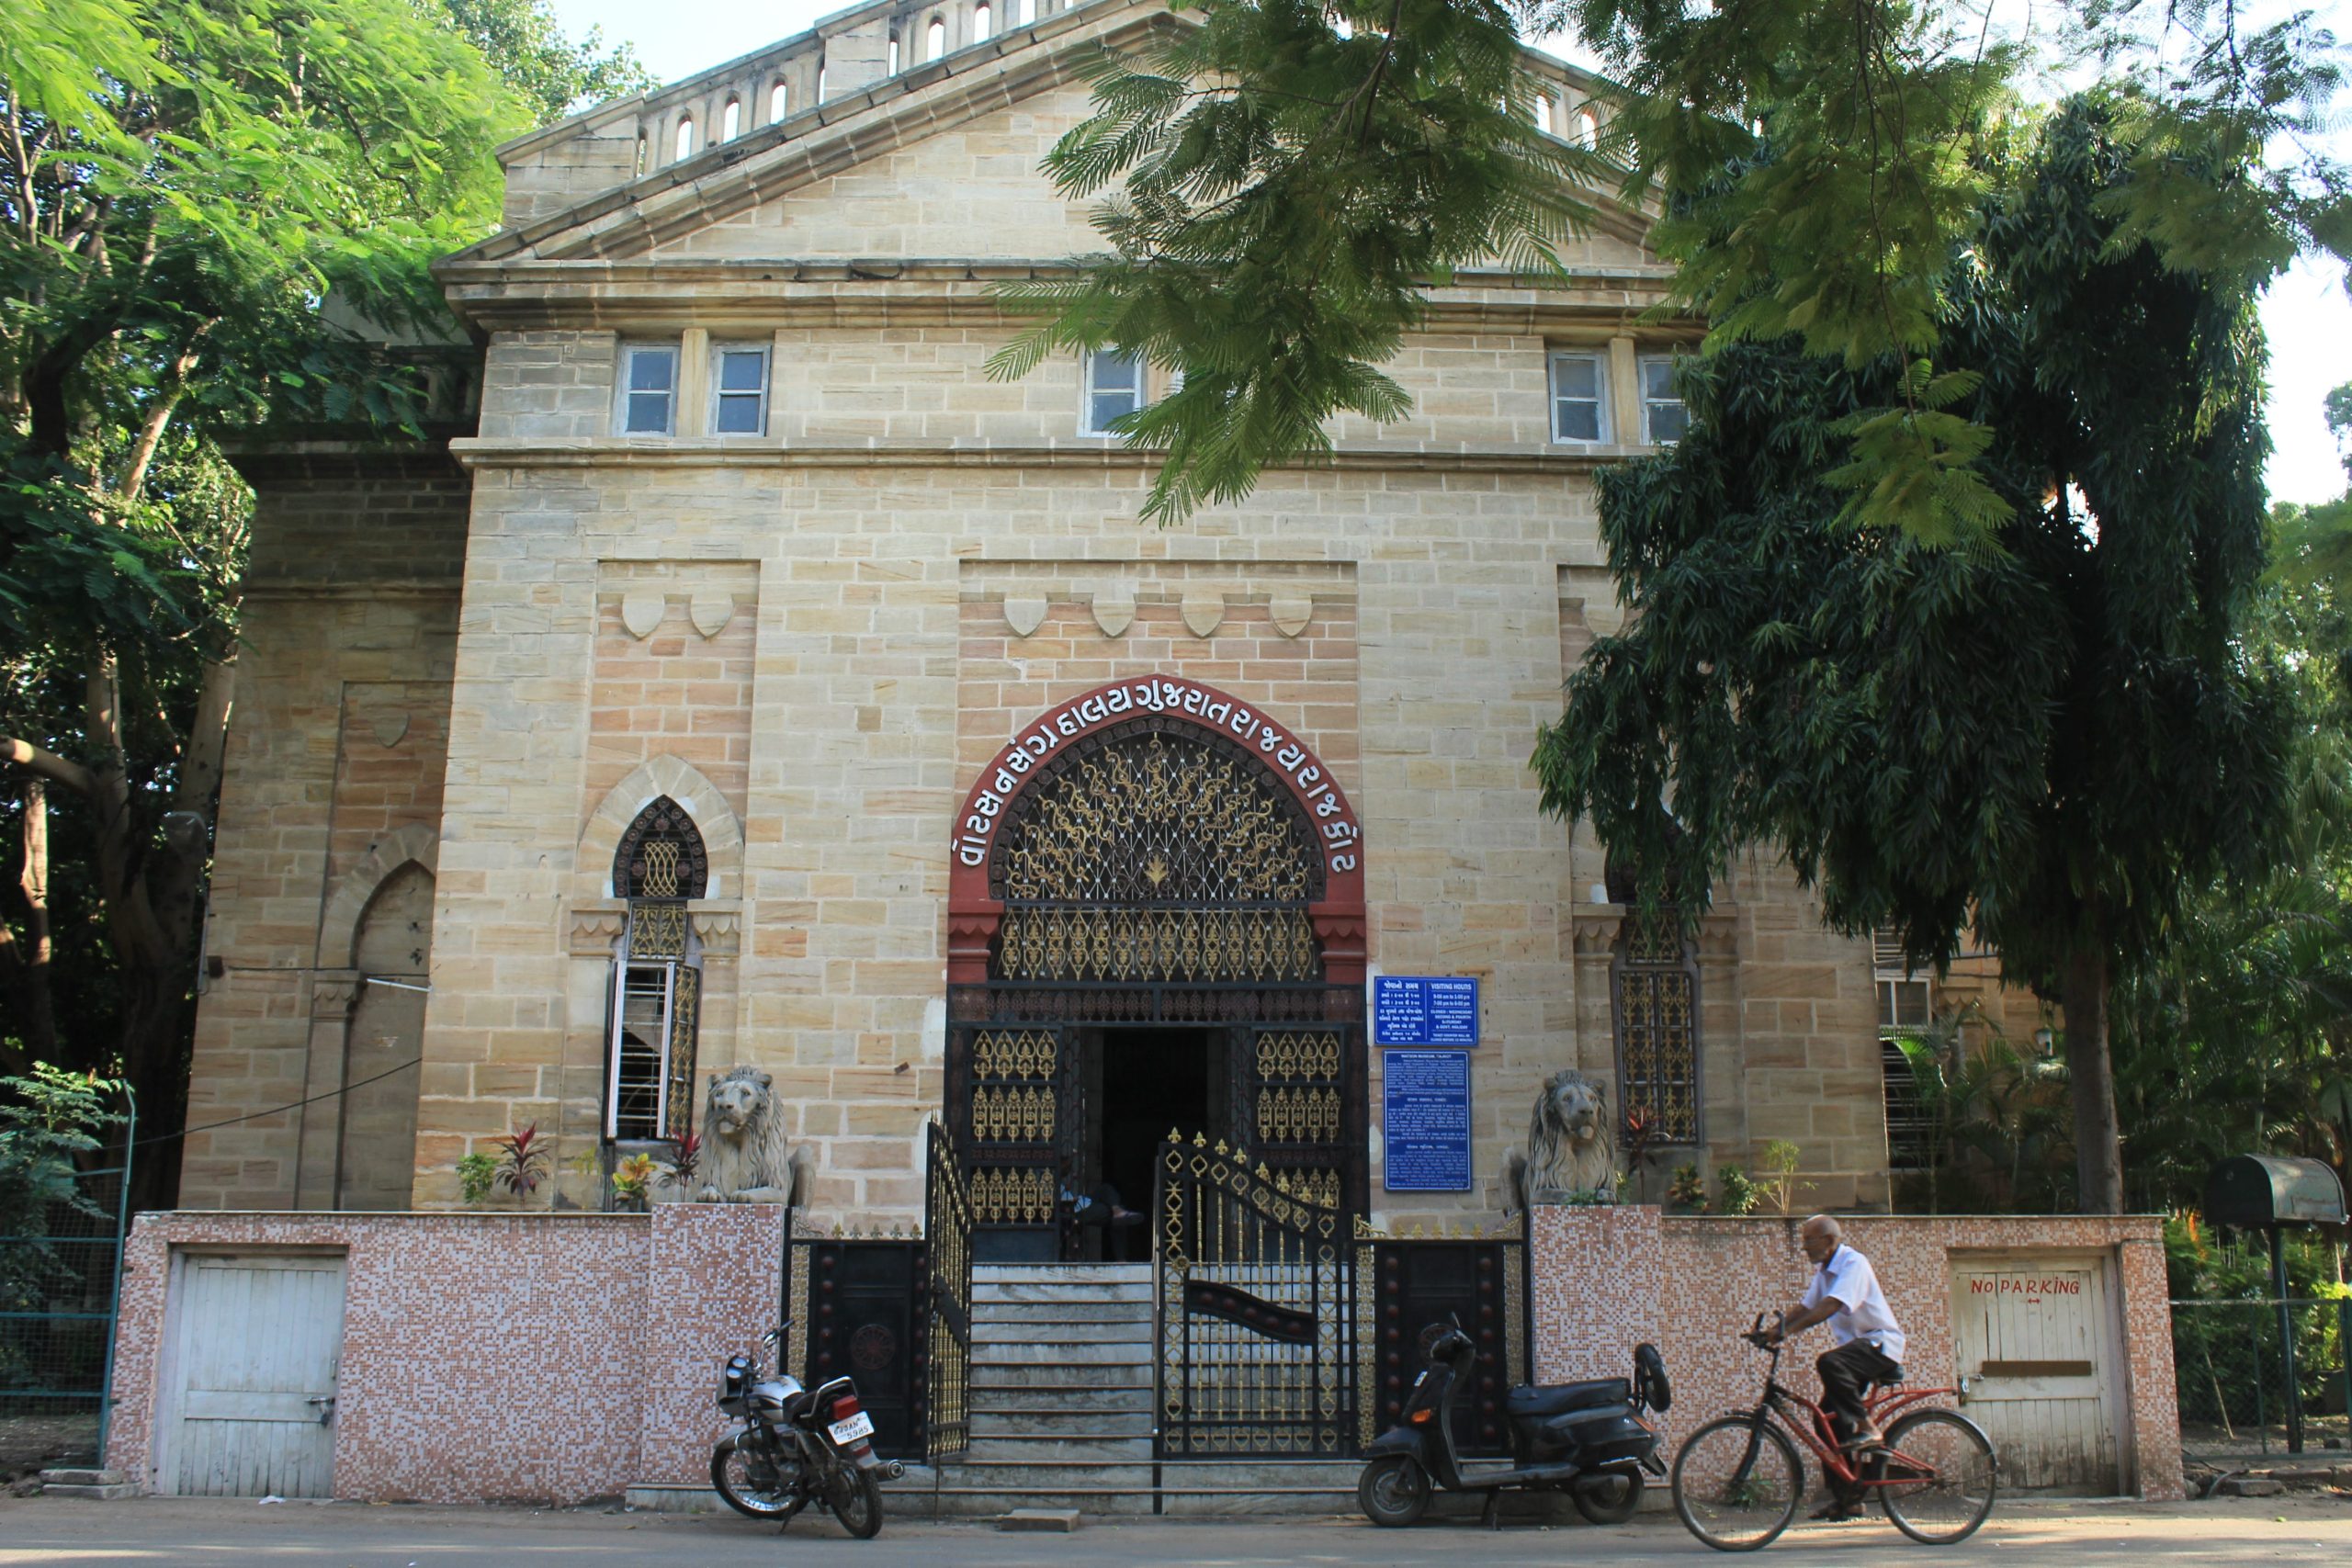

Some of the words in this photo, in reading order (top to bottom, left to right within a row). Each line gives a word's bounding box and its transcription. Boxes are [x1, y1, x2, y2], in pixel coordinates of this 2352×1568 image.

[1135, 678, 1232, 726] ગુજરાત
[1296, 764, 1358, 873] રાજકોટ
[1430, 982, 1453, 990] VISITING
